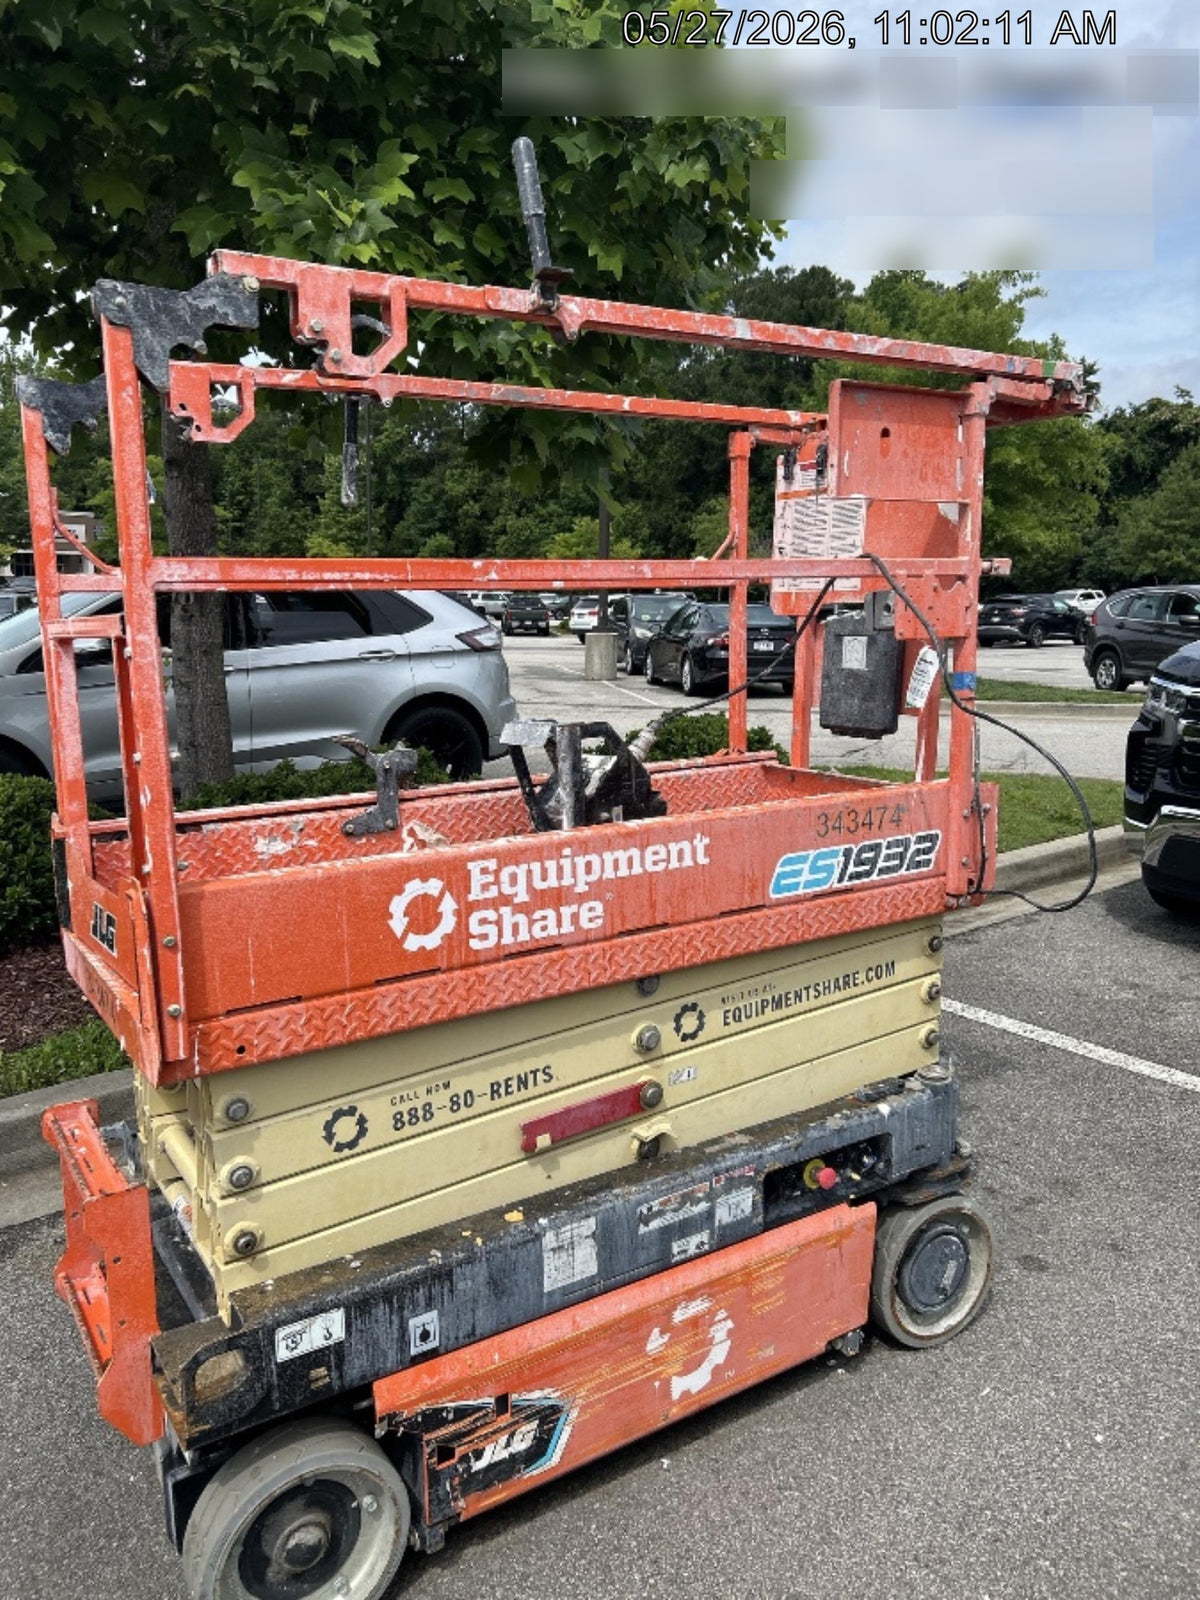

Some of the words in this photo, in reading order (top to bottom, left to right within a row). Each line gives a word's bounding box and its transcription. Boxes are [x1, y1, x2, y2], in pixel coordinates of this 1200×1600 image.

[816, 802, 903, 838] 343474
[466, 832, 710, 904] Equipment
[769, 829, 942, 898] ES1932
[91, 903, 116, 954] JLG
[468, 900, 605, 950] Share
[722, 960, 896, 1027] EQUIPMENTSHARE.COM
[390, 1090, 420, 1107] CALL
[425, 1080, 451, 1096] NOW
[392, 1064, 554, 1132] 888-80-RENTS
[469, 1420, 539, 1473] JLG
